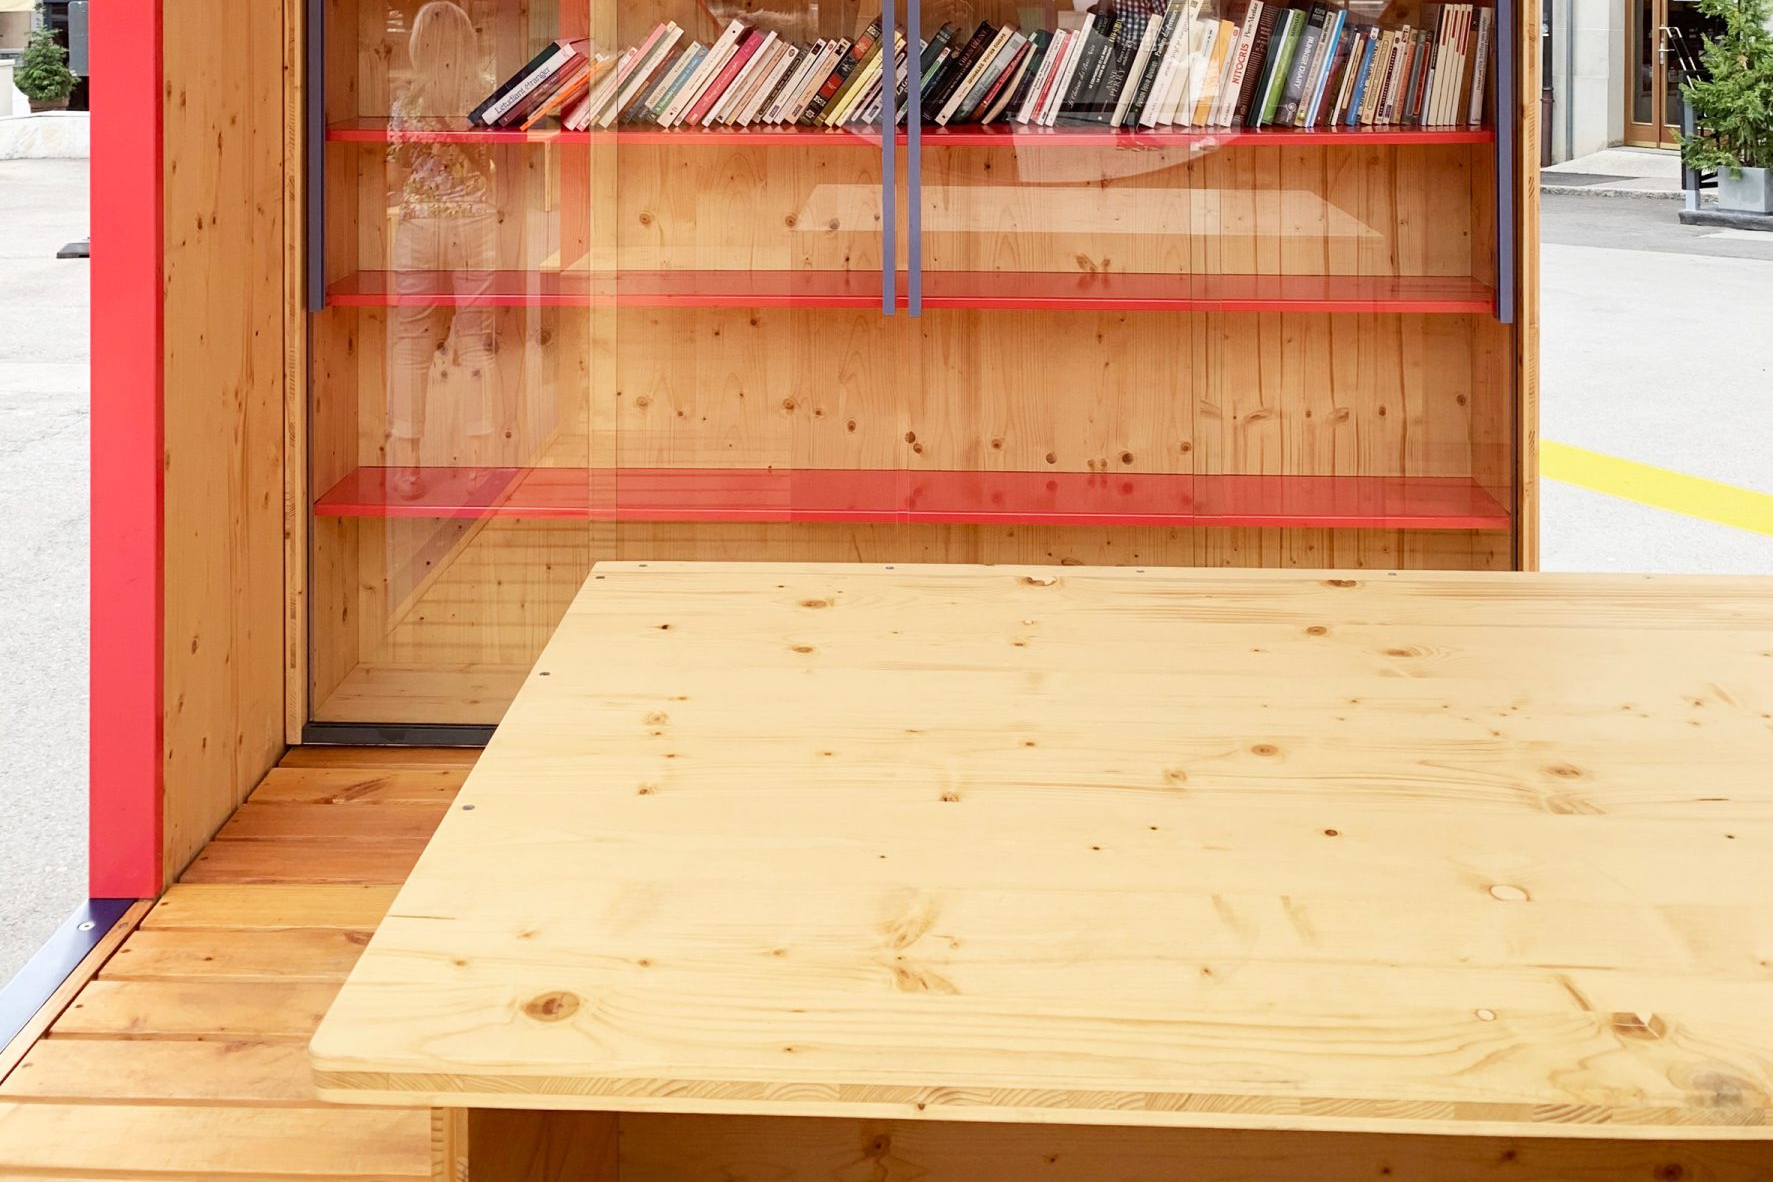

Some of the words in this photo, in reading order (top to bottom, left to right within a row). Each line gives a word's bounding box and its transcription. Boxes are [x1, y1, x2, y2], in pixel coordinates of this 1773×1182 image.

[1230, 42, 1250, 84] NITOCRIS
[1299, 35, 1315, 65] BUNKER
[1104, 67, 1118, 89] ANNE
[1108, 66, 1126, 97] PERRY
[1292, 65, 1306, 89] DIARY
